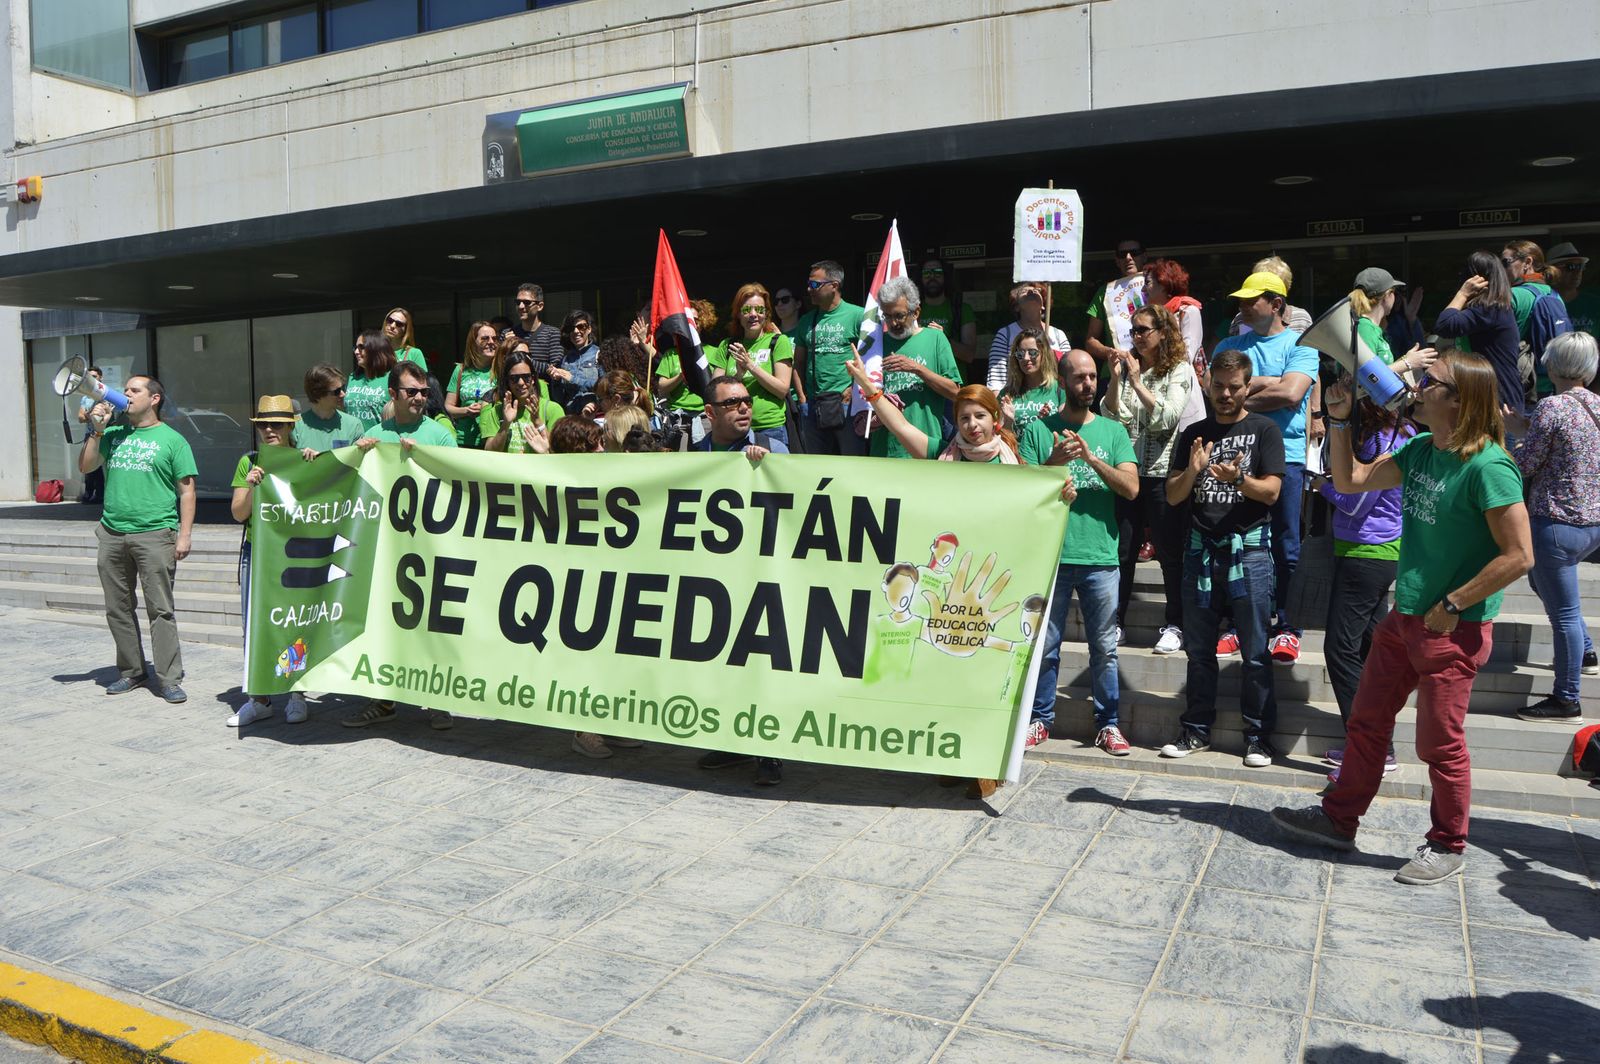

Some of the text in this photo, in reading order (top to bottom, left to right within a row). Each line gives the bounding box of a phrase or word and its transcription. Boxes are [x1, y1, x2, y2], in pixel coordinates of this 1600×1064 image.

[587, 115, 613, 130] JUNTA
[616, 113, 627, 125] DE
[642, 134, 650, 142] DE
[652, 131, 679, 141] CULTURA
[1026, 197, 1069, 213] Docentes
[1065, 211, 1074, 226] por
[1466, 211, 1513, 224] SALIDA
[1313, 222, 1357, 234] SALIDA
[945, 247, 981, 257] ENTRADA
[1114, 280, 1144, 303] Docent
[1210, 434, 1256, 457] GEND
[388, 475, 901, 565] QUIENES ESTÁN
[270, 601, 343, 628] CALIDAD
[391, 553, 872, 680] SE QUEDAN
[941, 603, 984, 617] POR LA
[927, 618, 996, 633] EDUCACIÓN
[880, 630, 911, 639] INTERINO
[935, 632, 985, 648] PÚBLICA
[350, 653, 962, 760] Asamblea de Interin@s de Almería
